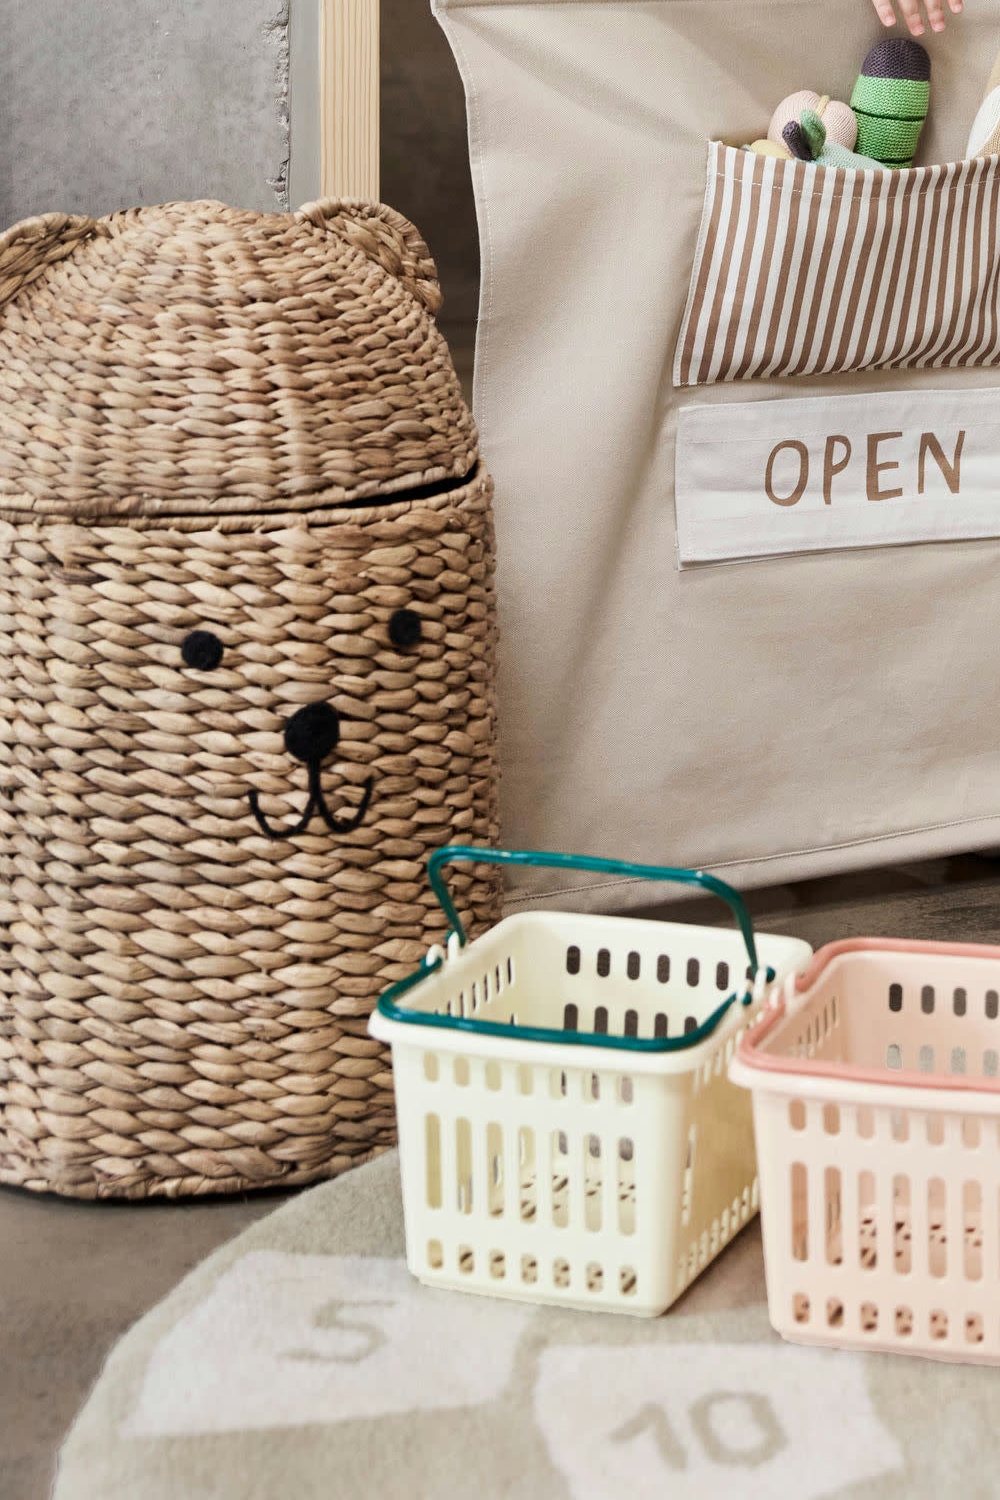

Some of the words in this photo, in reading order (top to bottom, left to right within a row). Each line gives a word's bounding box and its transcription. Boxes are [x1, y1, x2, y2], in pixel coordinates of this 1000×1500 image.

[763, 430, 966, 507] OPEN
[273, 1298, 401, 1366] 5
[607, 1387, 790, 1475] 10
